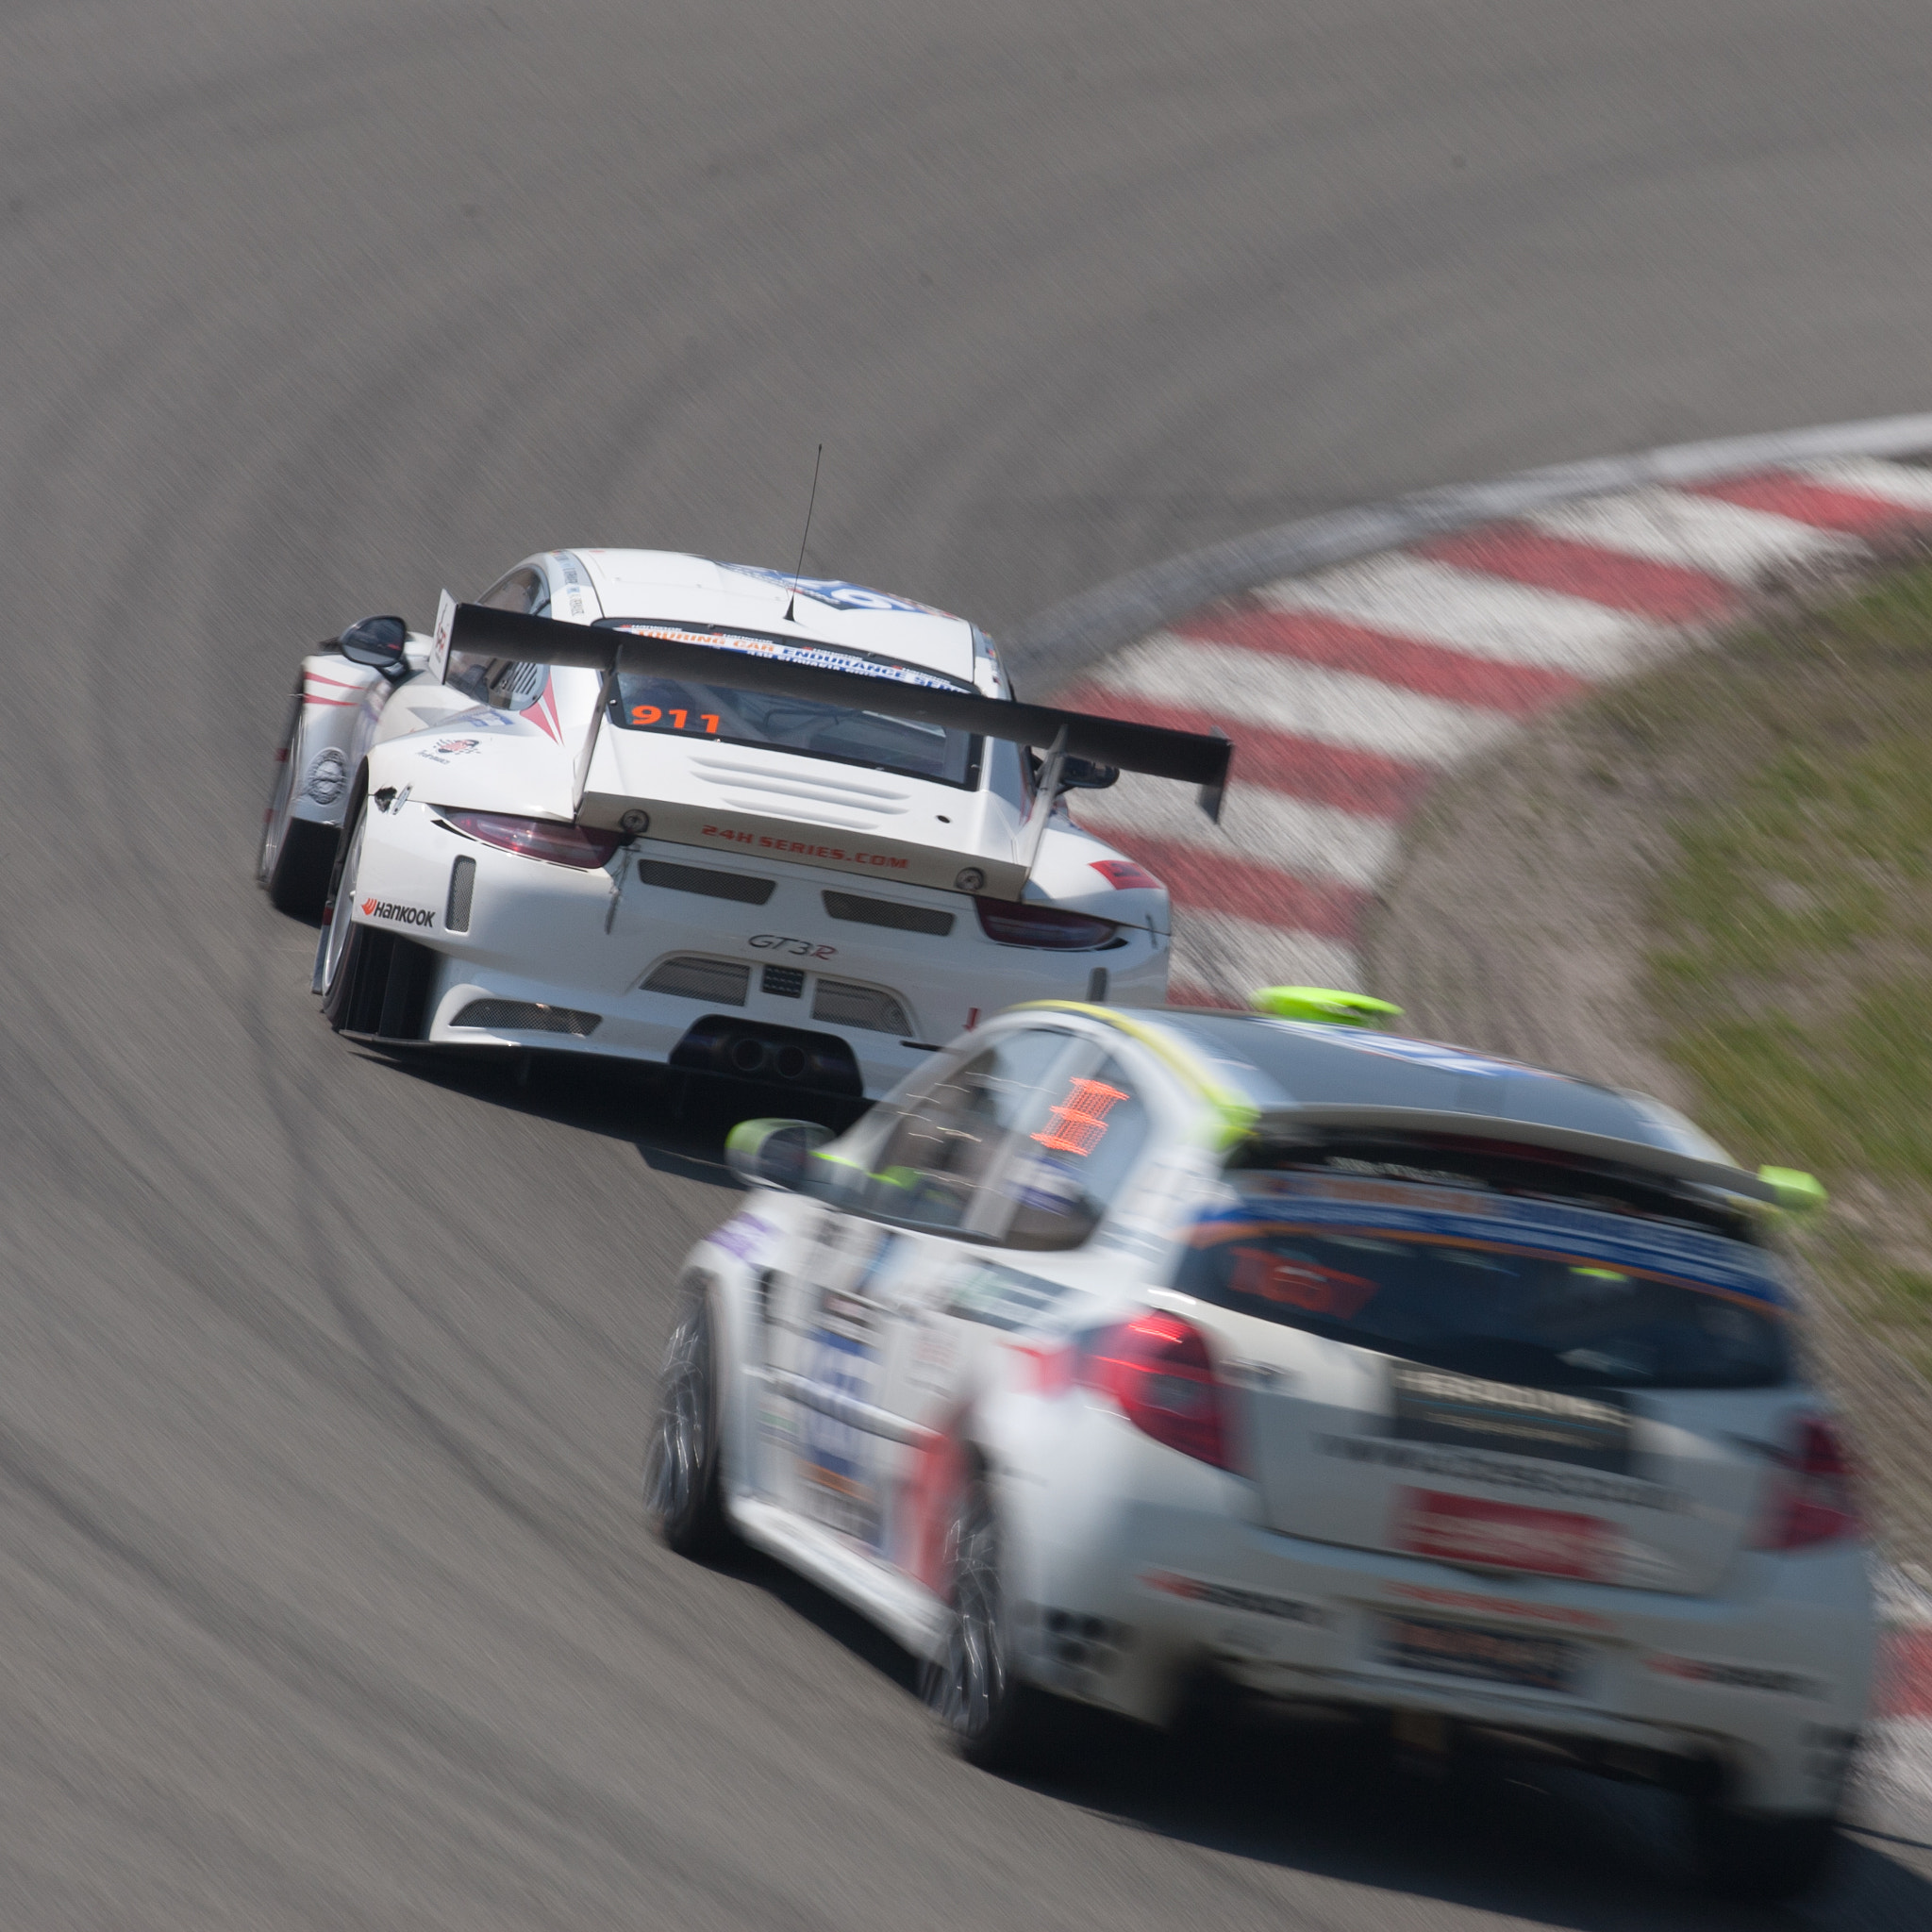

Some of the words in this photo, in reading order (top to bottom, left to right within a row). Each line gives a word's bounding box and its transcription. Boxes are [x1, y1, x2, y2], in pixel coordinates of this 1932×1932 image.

[733, 639, 775, 653] CAR
[782, 647, 907, 678] ENDURANCE
[631, 705, 720, 734] 911
[701, 824, 754, 844] 24H
[758, 836, 909, 869] SERIES.COM
